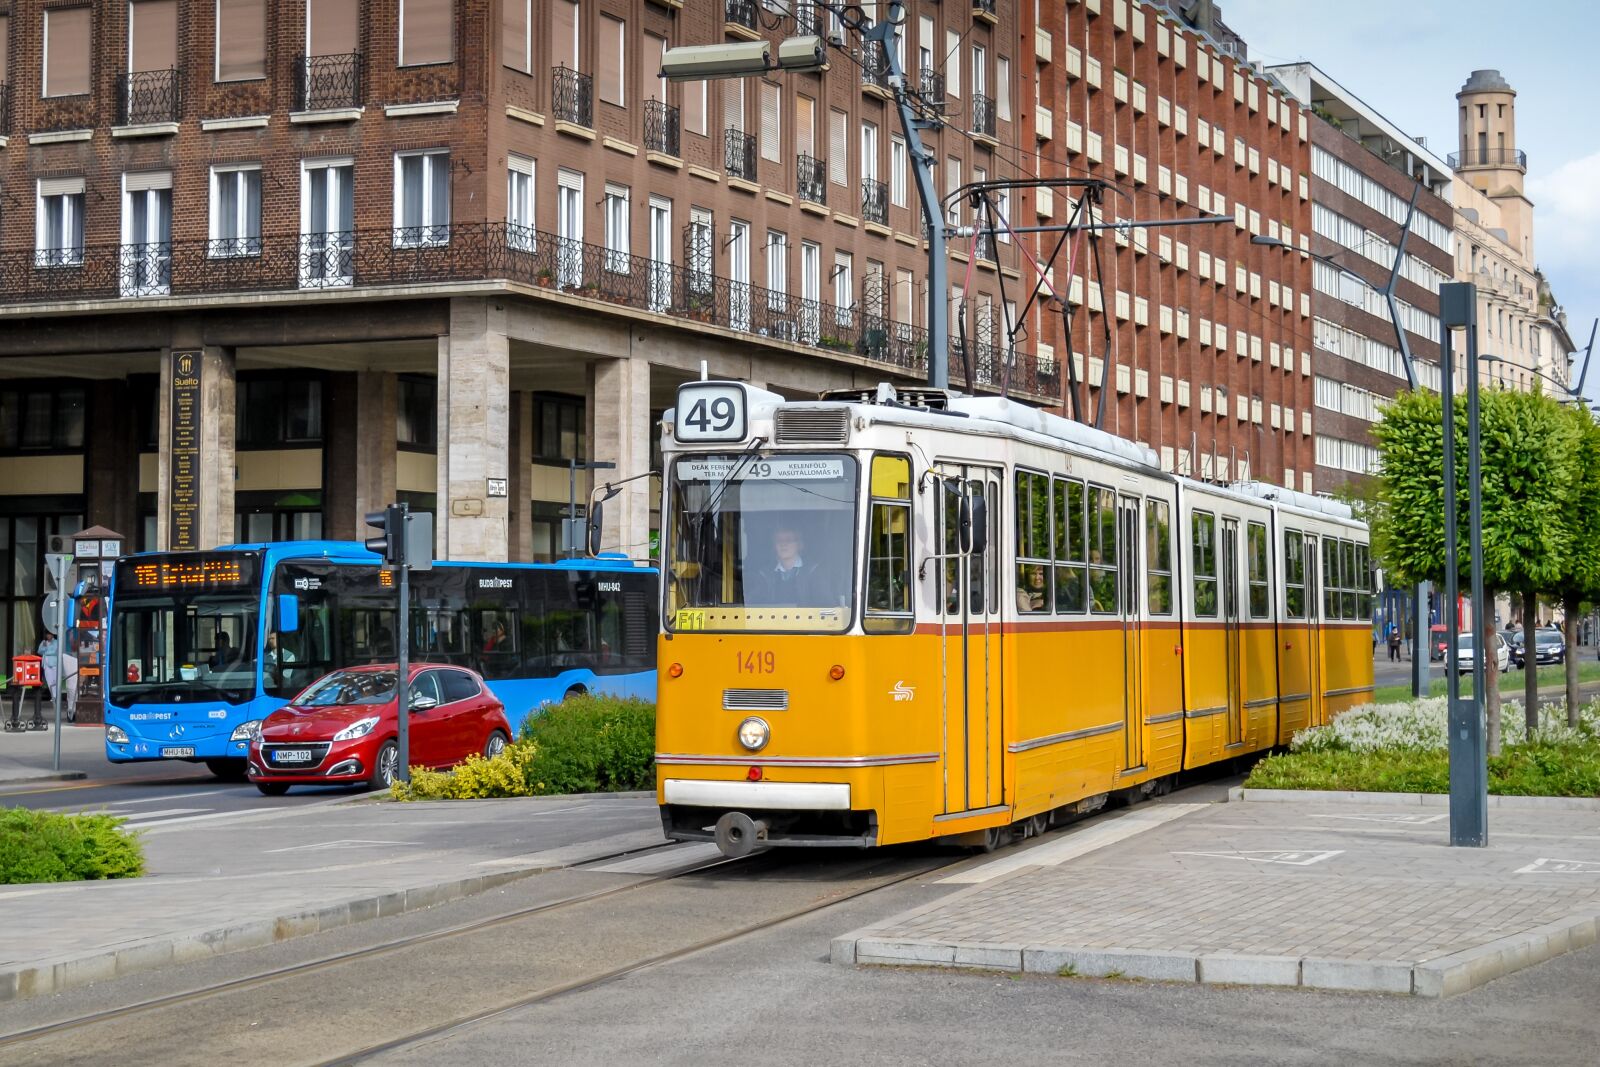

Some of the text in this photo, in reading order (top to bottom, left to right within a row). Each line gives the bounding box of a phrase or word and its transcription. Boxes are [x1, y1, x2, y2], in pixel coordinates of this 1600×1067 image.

[685, 397, 736, 432] 49
[749, 463, 772, 478] 49
[597, 582, 621, 592] MHU-842
[679, 612, 704, 630] F11
[737, 651, 775, 674] 1419
[163, 748, 193, 757] MHU-842
[276, 751, 310, 760] NMP-102
